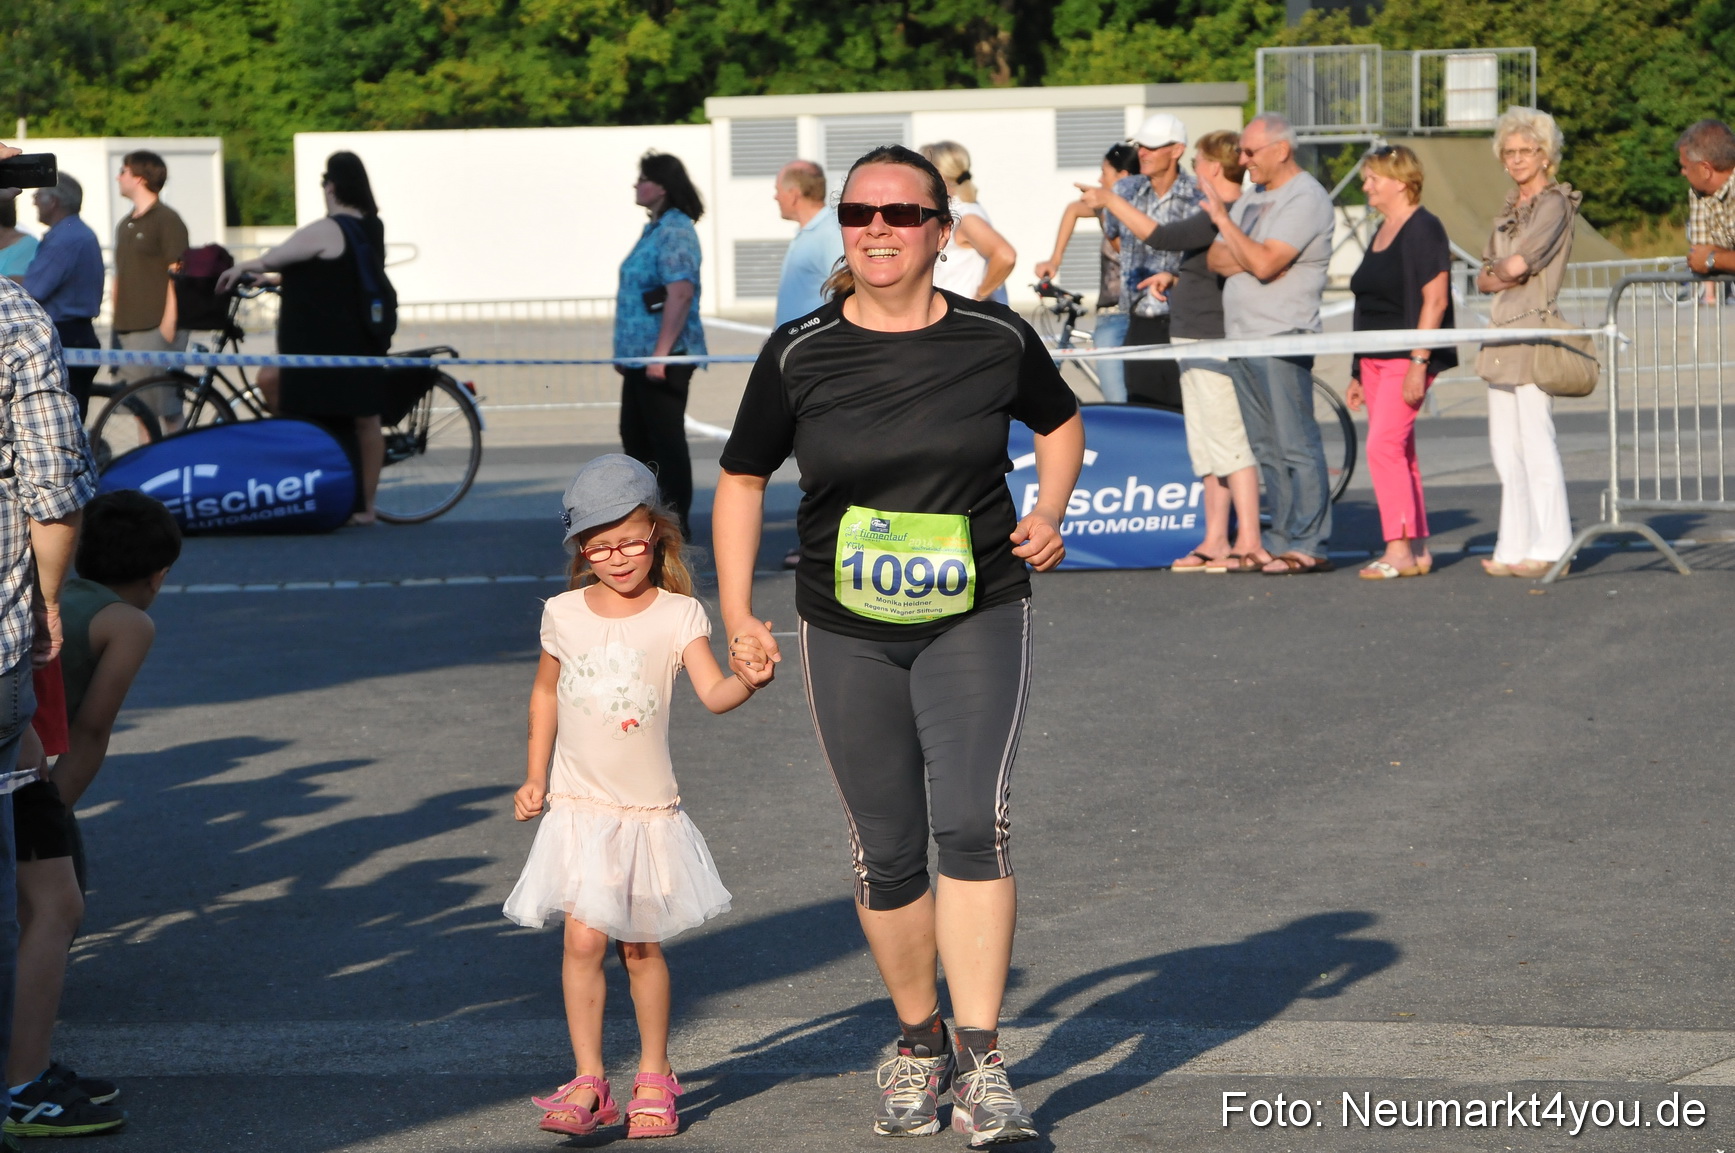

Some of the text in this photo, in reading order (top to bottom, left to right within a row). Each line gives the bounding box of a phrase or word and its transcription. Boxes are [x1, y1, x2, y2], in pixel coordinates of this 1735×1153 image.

[800, 317, 821, 330] JAKO
[1021, 475, 1205, 519] Fscher
[186, 499, 317, 529] AUTOMOBILE
[1059, 513, 1197, 536] UTOMOBILE
[859, 528, 909, 542] firmenlauf
[842, 551, 968, 599] 1090
[864, 602, 889, 613] Regens
[889, 607, 916, 617] Wagner
[916, 606, 943, 616] Stiftung
[876, 596, 902, 607] Monika
